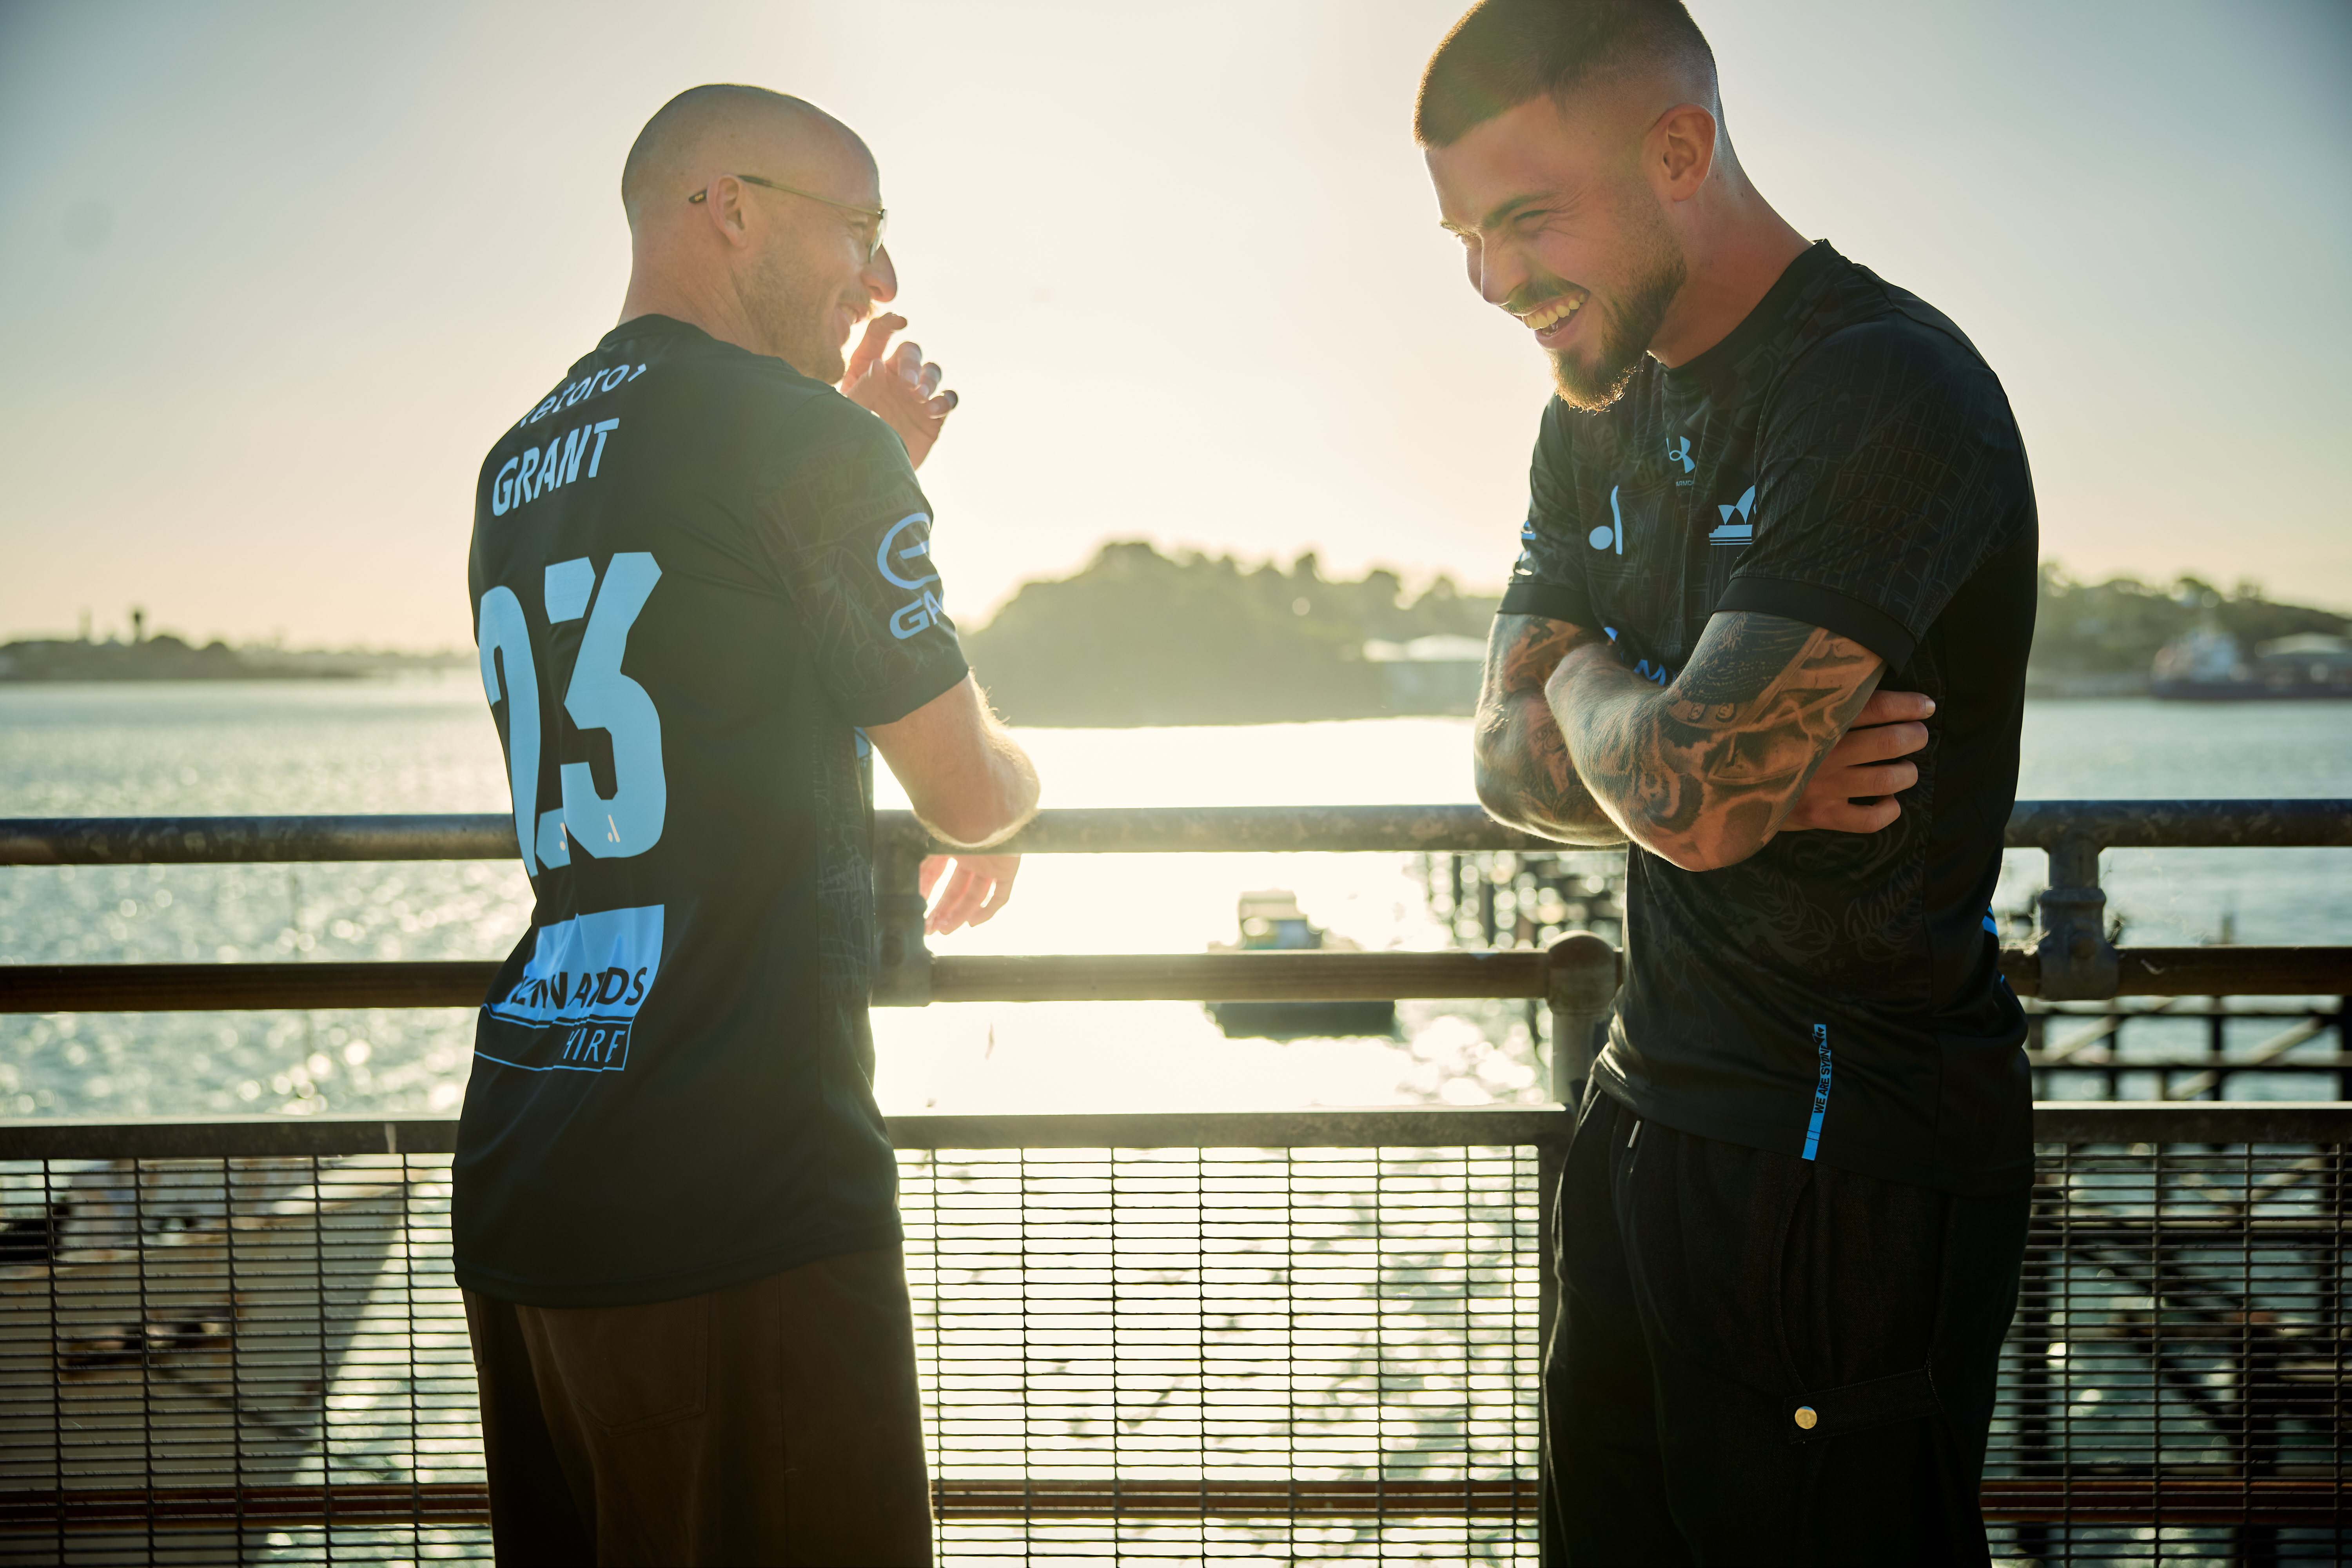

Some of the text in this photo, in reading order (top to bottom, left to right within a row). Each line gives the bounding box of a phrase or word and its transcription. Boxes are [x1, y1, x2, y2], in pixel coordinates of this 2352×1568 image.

[492, 417, 620, 516] GRANT
[889, 588, 944, 639] GA
[479, 552, 667, 877] 23
[1814, 1097, 1826, 1113] WE
[1818, 1078, 1829, 1096] ARE
